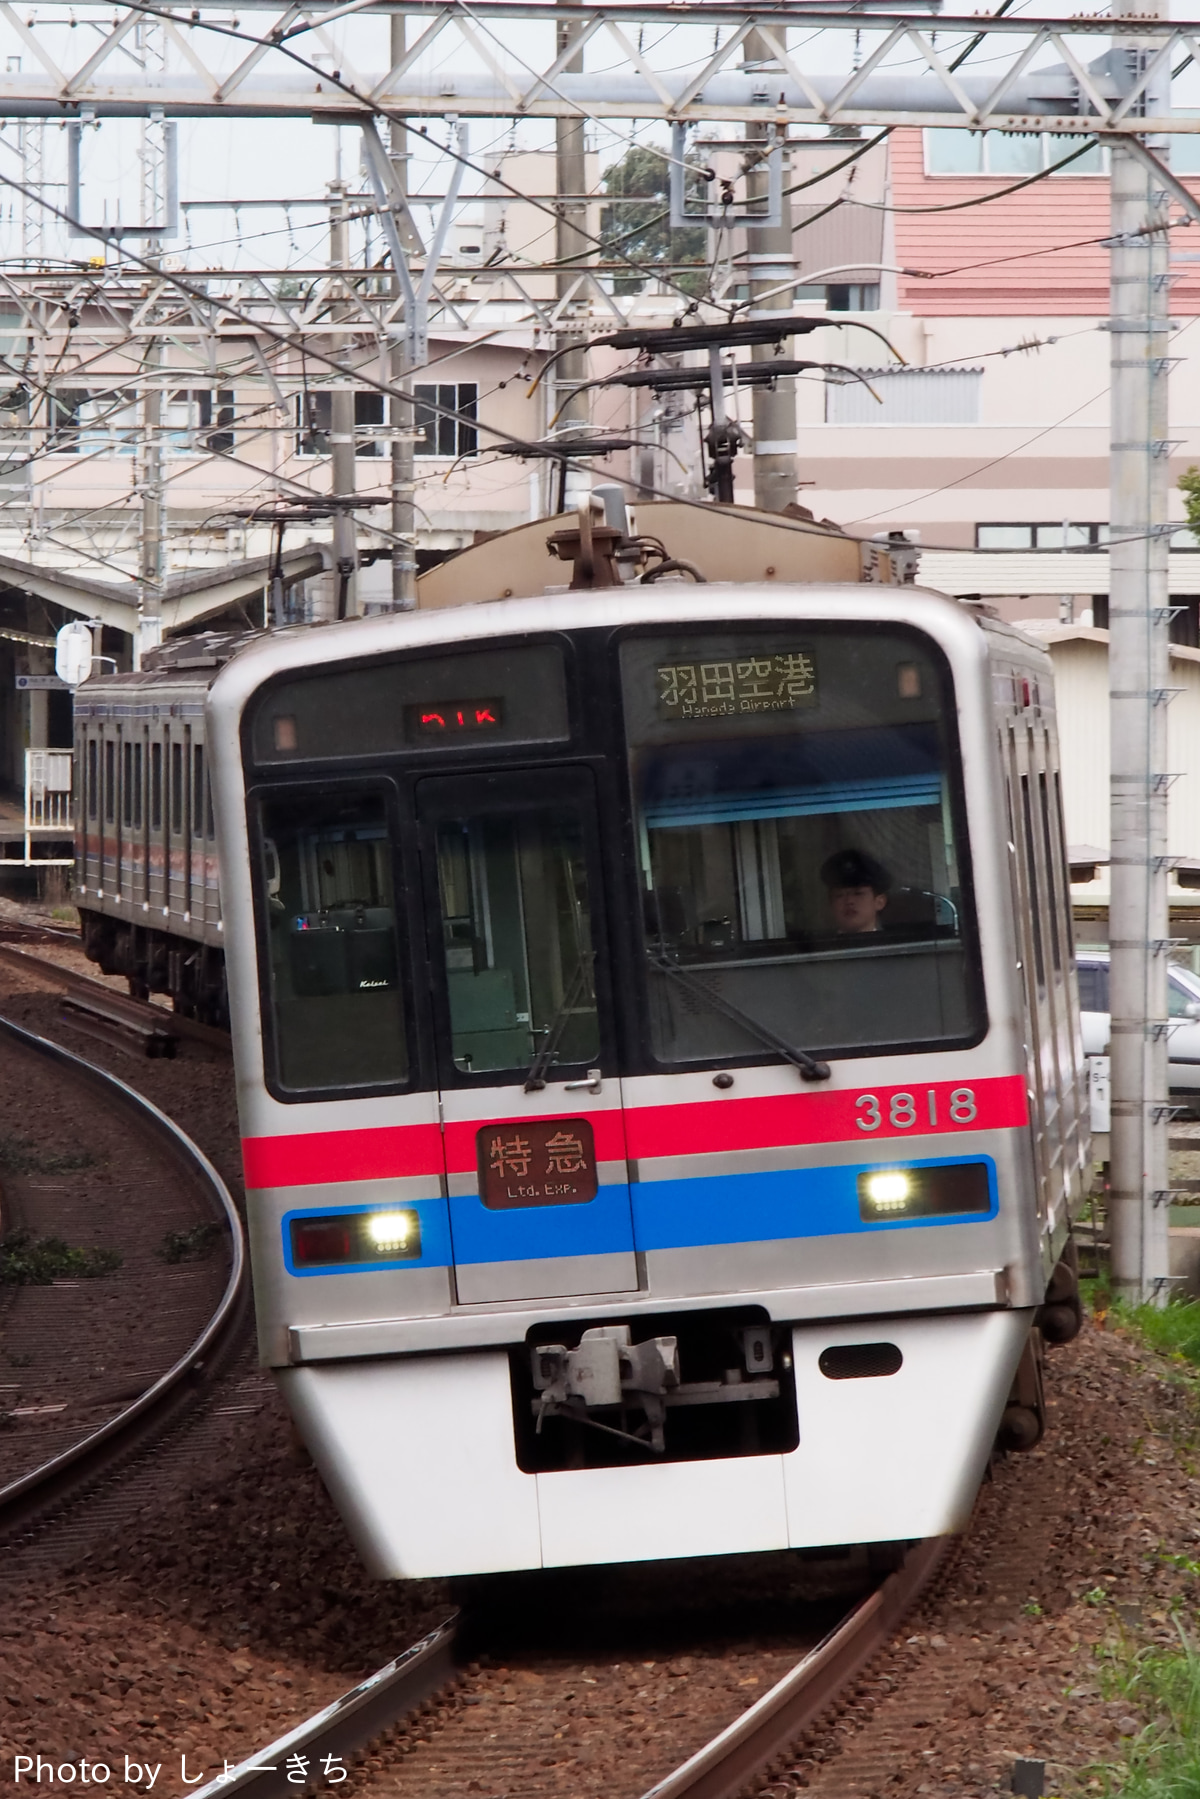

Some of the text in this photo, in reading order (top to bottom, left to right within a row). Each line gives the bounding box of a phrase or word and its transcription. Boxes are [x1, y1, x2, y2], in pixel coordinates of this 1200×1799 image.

[657, 653, 816, 706] 羽田空港
[855, 1087, 978, 1132] 3818
[490, 1131, 588, 1178] 特急
[507, 1184, 540, 1198] Ltd.
